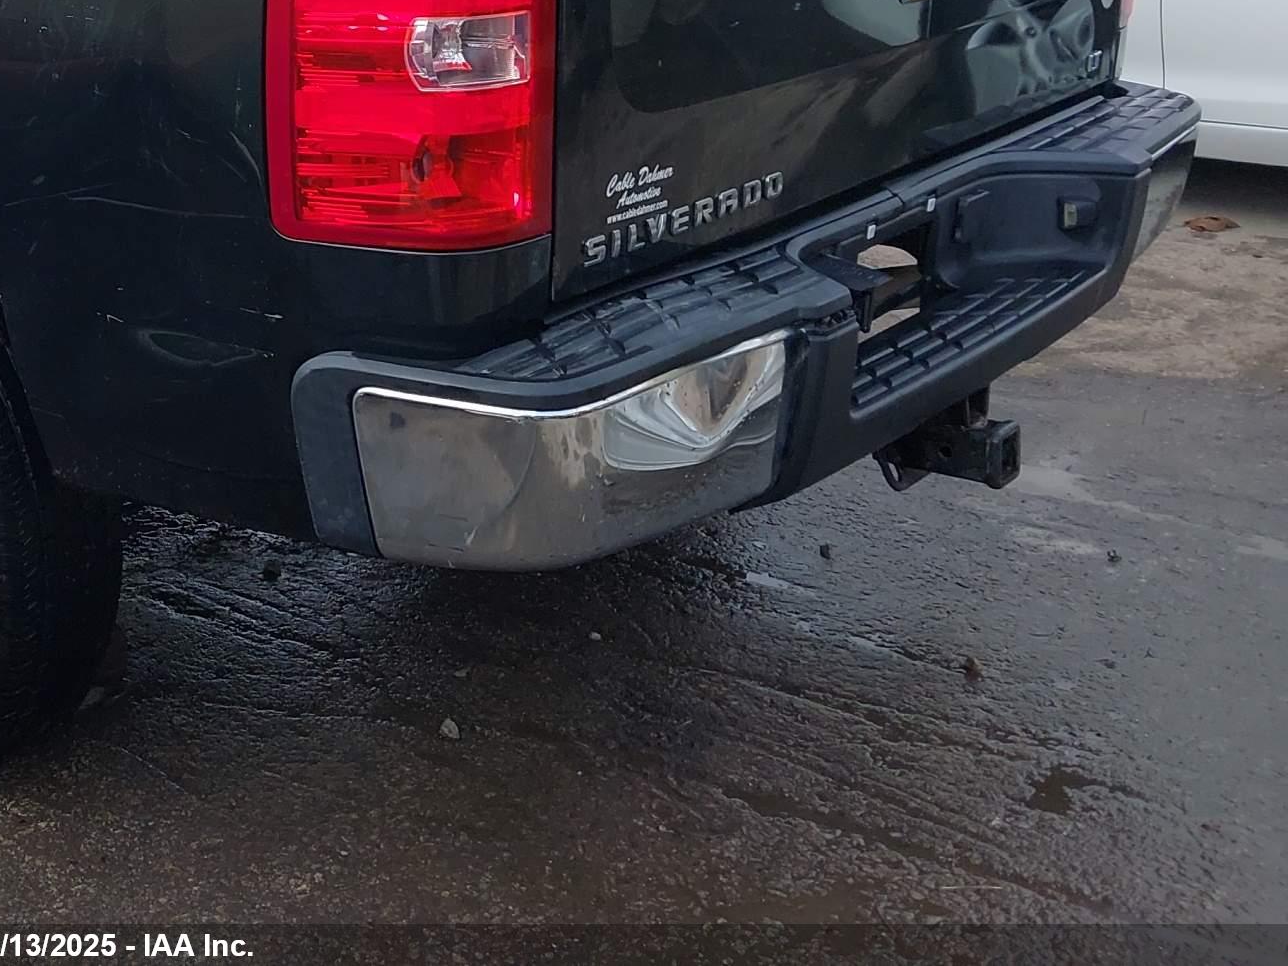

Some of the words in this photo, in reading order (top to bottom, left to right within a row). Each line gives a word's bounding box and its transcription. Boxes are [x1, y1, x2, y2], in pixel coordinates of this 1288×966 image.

[606, 171, 636, 198] Cable
[616, 186, 662, 209] Automotive
[583, 171, 784, 267] SILVERADO
